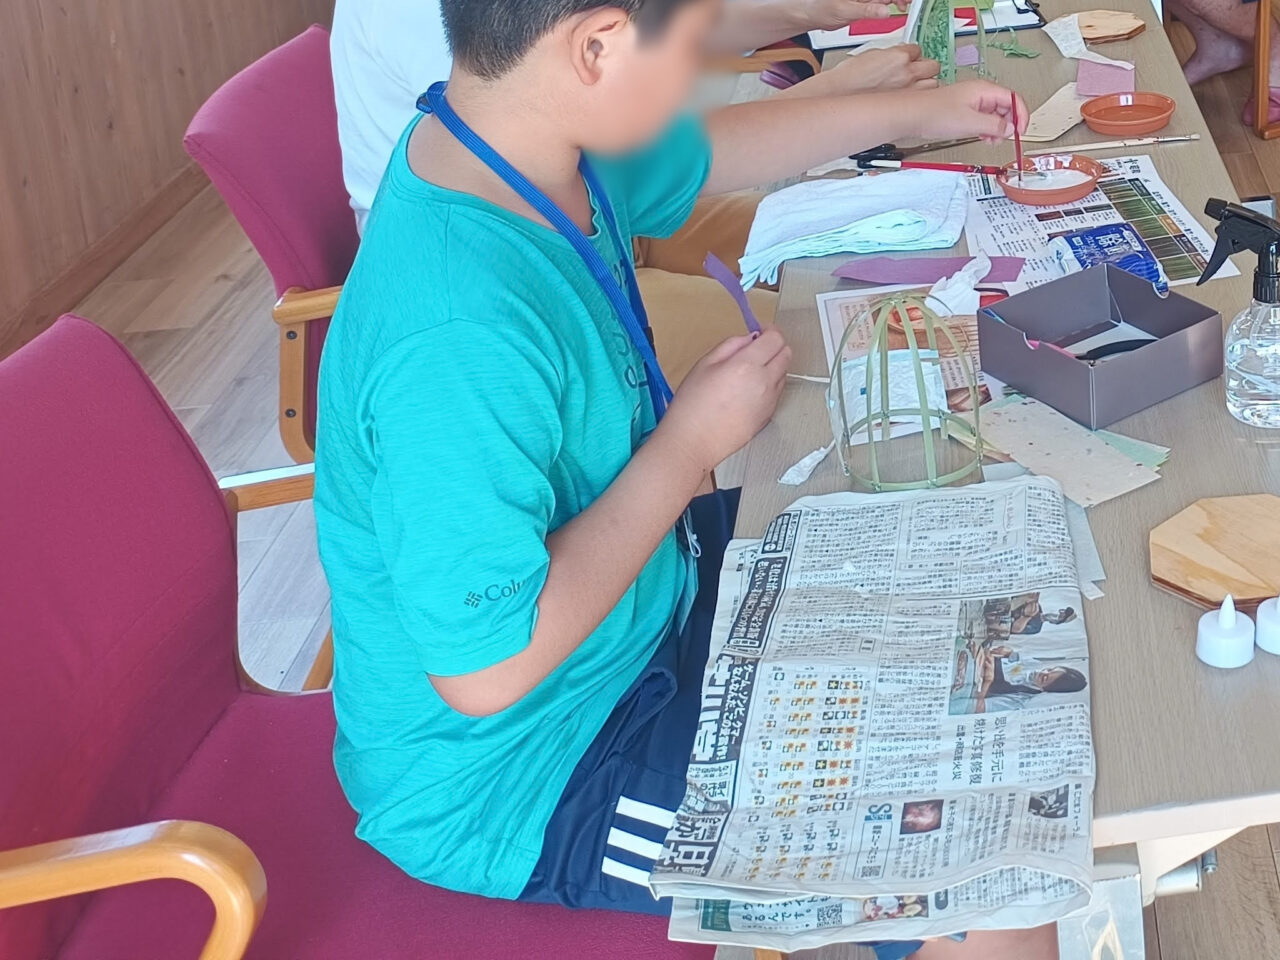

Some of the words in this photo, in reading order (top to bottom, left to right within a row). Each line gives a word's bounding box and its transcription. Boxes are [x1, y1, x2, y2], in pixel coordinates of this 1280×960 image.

[990, 716, 1008, 783] 思い出を手元に
